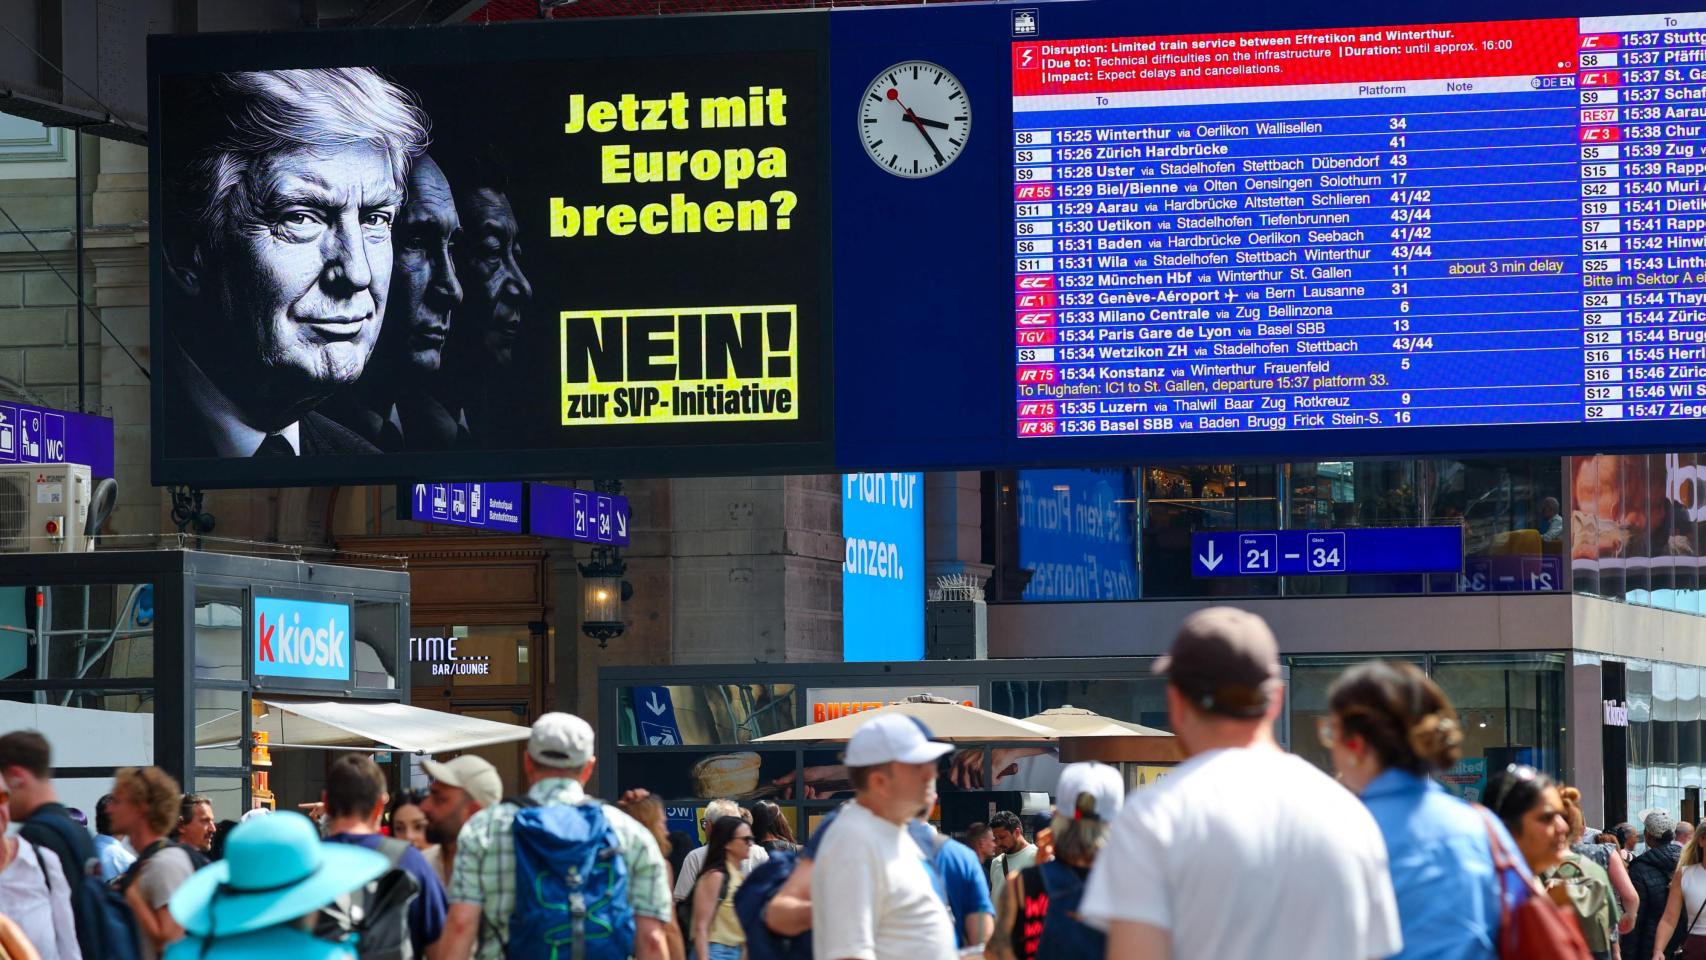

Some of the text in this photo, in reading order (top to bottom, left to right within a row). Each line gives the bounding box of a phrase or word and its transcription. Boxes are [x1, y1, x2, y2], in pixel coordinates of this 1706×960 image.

[1664, 17, 1678, 26] To
[1041, 28, 1454, 56] Disruption: Limited train service between Effretikon and Winterthur.
[1622, 33, 1660, 46] 15:37
[1073, 58, 1090, 67] to:
[1094, 54, 1148, 66] Technical
[1151, 53, 1211, 64] difficulties
[1214, 53, 1229, 61] on
[1232, 51, 1250, 60] the
[1254, 48, 1331, 60] infrastructure
[1405, 43, 1430, 53] until
[1433, 43, 1477, 54] approx.
[1481, 39, 1512, 50] 16:00
[1096, 69, 1136, 82] Expect
[1139, 67, 1176, 80] delays
[1180, 66, 1201, 76] and
[1204, 63, 1282, 75] cancellations.
[1096, 77, 1575, 105] To Platform Note DE EN
[564, 86, 787, 134] Jetzt mit
[1583, 110, 1615, 121] RE37
[1623, 108, 1661, 120] 15:38
[1018, 117, 1407, 143] S8 15:25 Winterthur via Oerlikon Wallisellen 34
[1602, 128, 1610, 139] 3
[1624, 126, 1661, 138] 15:38
[1665, 125, 1701, 137] Chur
[1018, 135, 1405, 161] S3 15:26 Zürich Hardbrücke 41
[1583, 144, 1694, 158] S5 15:39 Zug
[602, 144, 787, 189] Europa
[1018, 154, 1407, 179] S9 15:28 Uster via Stadelhofen Stettbach Dübendorf 43
[1584, 180, 1699, 196] S42 15:40 Muri
[550, 190, 798, 237] brechen?
[1057, 274, 1094, 287] 15:32
[1098, 273, 1162, 286] München
[1166, 271, 1192, 284] Hbf
[1197, 273, 1211, 282] via
[1216, 269, 1283, 282] Winterthur
[1290, 267, 1307, 280] St.
[1311, 266, 1351, 279] Gallen
[1392, 264, 1407, 276] 11
[1448, 262, 1486, 274] about
[1489, 260, 1498, 273] 3
[1501, 260, 1525, 272] min
[1528, 259, 1563, 273] delay
[1584, 272, 1693, 287] Bitte im Sektor A
[1058, 292, 1094, 306] 15:32
[1098, 289, 1220, 304] Genève-Aéroport
[1245, 290, 1259, 299] via
[1265, 286, 1295, 298] Bern
[1303, 285, 1365, 297] Lausanne
[1391, 282, 1407, 294] 31
[1058, 310, 1094, 323] 15:33
[1098, 310, 1145, 322] Milano
[1149, 307, 1210, 320] Centrale
[1215, 309, 1229, 318] via
[1235, 306, 1260, 320] Zug
[1268, 304, 1333, 317] Bellinzona
[1399, 300, 1409, 312] 6
[566, 312, 791, 383] NEIN!
[1040, 370, 1053, 380] 75
[1059, 367, 1095, 380] 15:34
[1099, 366, 1165, 379] Konstanz
[1171, 367, 1185, 376] via
[1190, 363, 1256, 376] Winterthur
[1263, 360, 1329, 374] Frauenfeld
[1400, 357, 1410, 370] 5
[1018, 373, 1389, 399] To Flughafen: IC1 to St. Gallen, departure 15:37 platform 33.
[1587, 384, 1692, 399] S12 15:46 Wil
[567, 383, 792, 419] zur SVP-Initiative
[47, 438, 63, 461] WC
[576, 510, 584, 532] 21
[600, 514, 610, 534] 34
[843, 537, 903, 580] anzen.
[1246, 549, 1269, 568] 21
[1313, 547, 1340, 568] 34
[432, 663, 489, 676] BAR/LOUNGE
